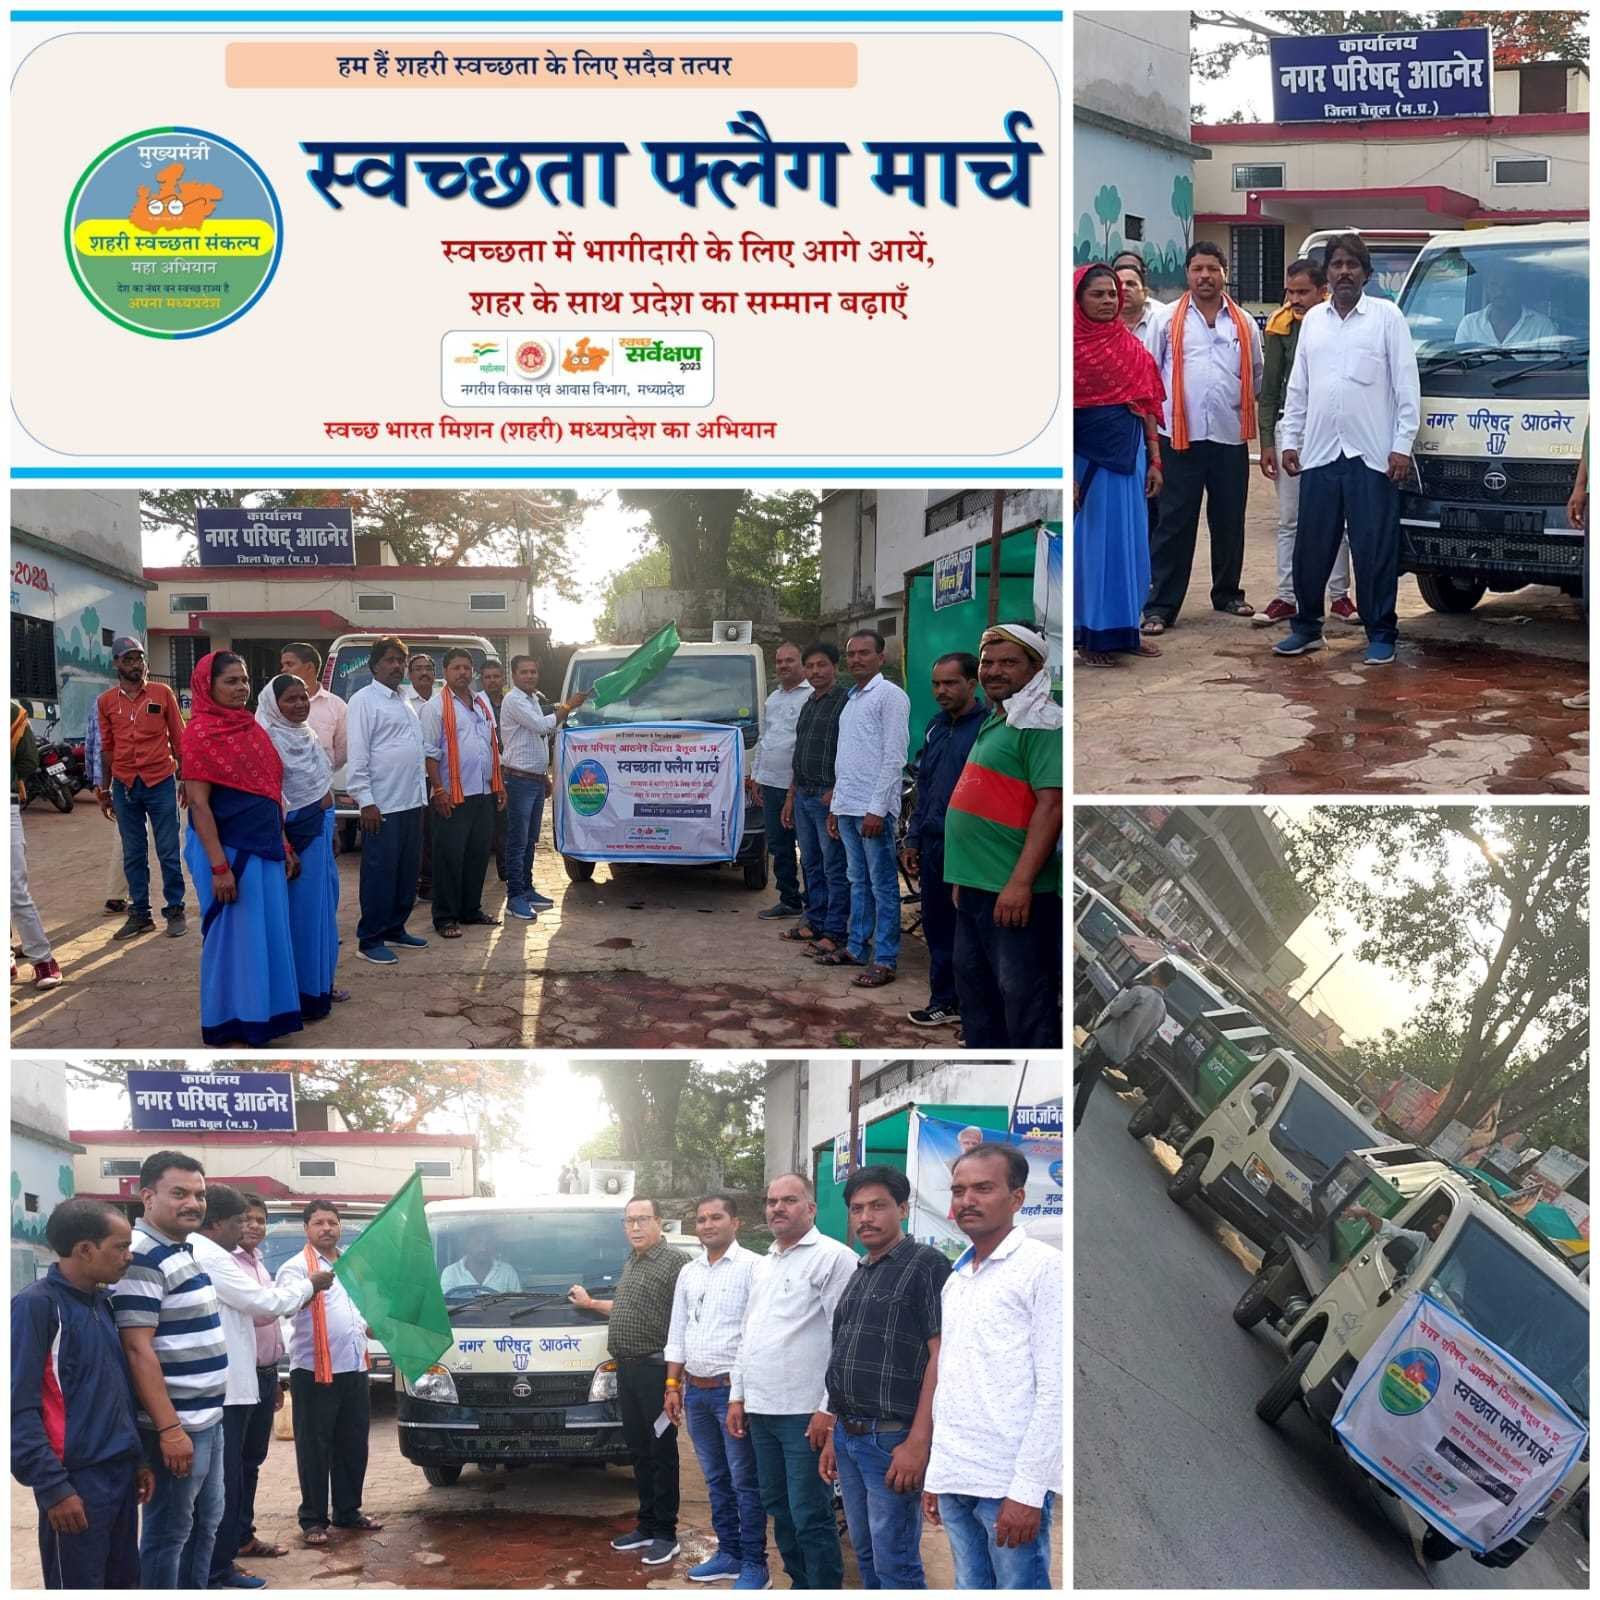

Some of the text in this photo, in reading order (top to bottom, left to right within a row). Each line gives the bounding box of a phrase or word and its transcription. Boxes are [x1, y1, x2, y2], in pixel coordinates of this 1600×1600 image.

[1338, 34, 1419, 53] कार्यालय
[336, 49, 734, 80] हम हैं शहरी स्वच्छता के लिए सदैव तत्पर
[1279, 50, 1485, 98] नगर परिषद् आठनेर
[1324, 104, 1357, 118] जिला
[1395, 101, 1440, 117] (म.प्र.)
[136, 141, 211, 169] मुख्यमंत्री
[298, 110, 1045, 213] स्वच्छता फ्लैग मार्च
[89, 231, 261, 251] शहरी स्वच्छता संकल्प
[440, 230, 935, 269] स्वच्छता में भागीदारी के लिए आगे आयें,
[131, 257, 218, 275] महा अभियान
[468, 282, 910, 320] शहर के साथ प्रदेश का सम्मान बढ़ाएँ
[625, 341, 703, 363] सर्वेक्षण
[679, 362, 702, 373] 2023
[460, 380, 686, 398] नगरीय विकास एवं आवास विभाग, मध्यप्रदेश
[323, 414, 778, 443] स्वच्छ भारत मिशन (शहरी) मध्यप्रदेश का अभियान
[1425, 413, 1459, 431] नगर
[1521, 410, 1576, 433] आठनेर
[247, 509, 303, 521] कार्यालय
[204, 522, 349, 552] नगर परिषद् आठनेर
[237, 554, 262, 564] जिला
[616, 755, 721, 774] स्वच्छता फ्लैग मार्च
[181, 1073, 241, 1085] कार्यालय
[136, 1086, 289, 1117] नगर परिषद् आठनेर
[172, 1118, 197, 1128] जिला
[458, 1339, 487, 1354] नगर
[539, 1334, 582, 1353] आठनेर
[1454, 1377, 1502, 1424] स्वच्छता
[1499, 1414, 1530, 1448] फ्लैग
[1526, 1438, 1555, 1467] मार्च
